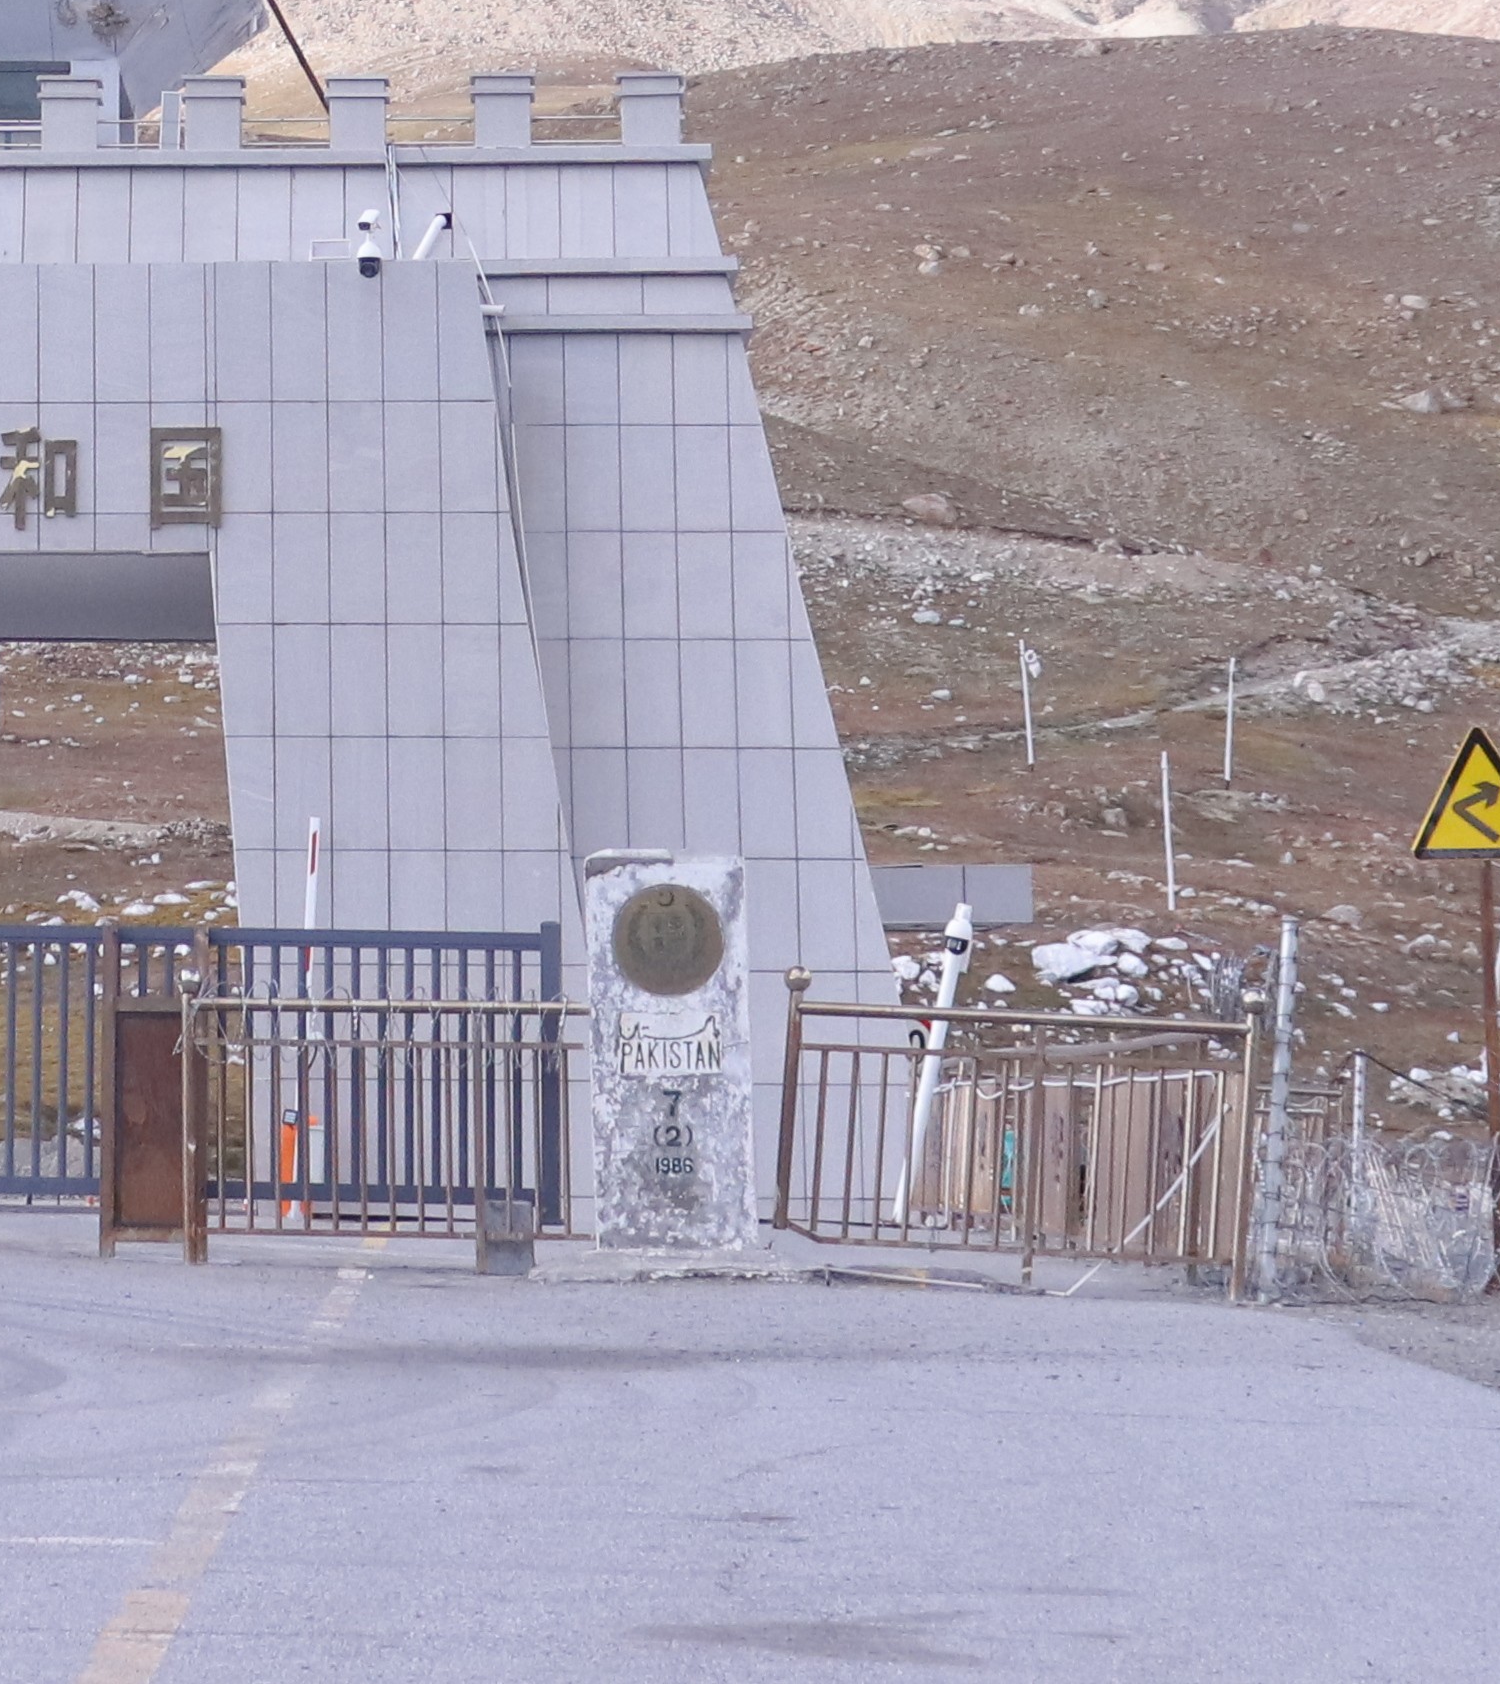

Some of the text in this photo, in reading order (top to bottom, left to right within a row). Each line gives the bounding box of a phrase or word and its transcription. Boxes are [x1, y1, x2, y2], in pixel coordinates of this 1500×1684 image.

[620, 1041, 721, 1073] PAKISTAN
[663, 1090, 682, 1116] 7
[653, 1126, 693, 1147] (2)
[655, 1157, 694, 1174] 1986
